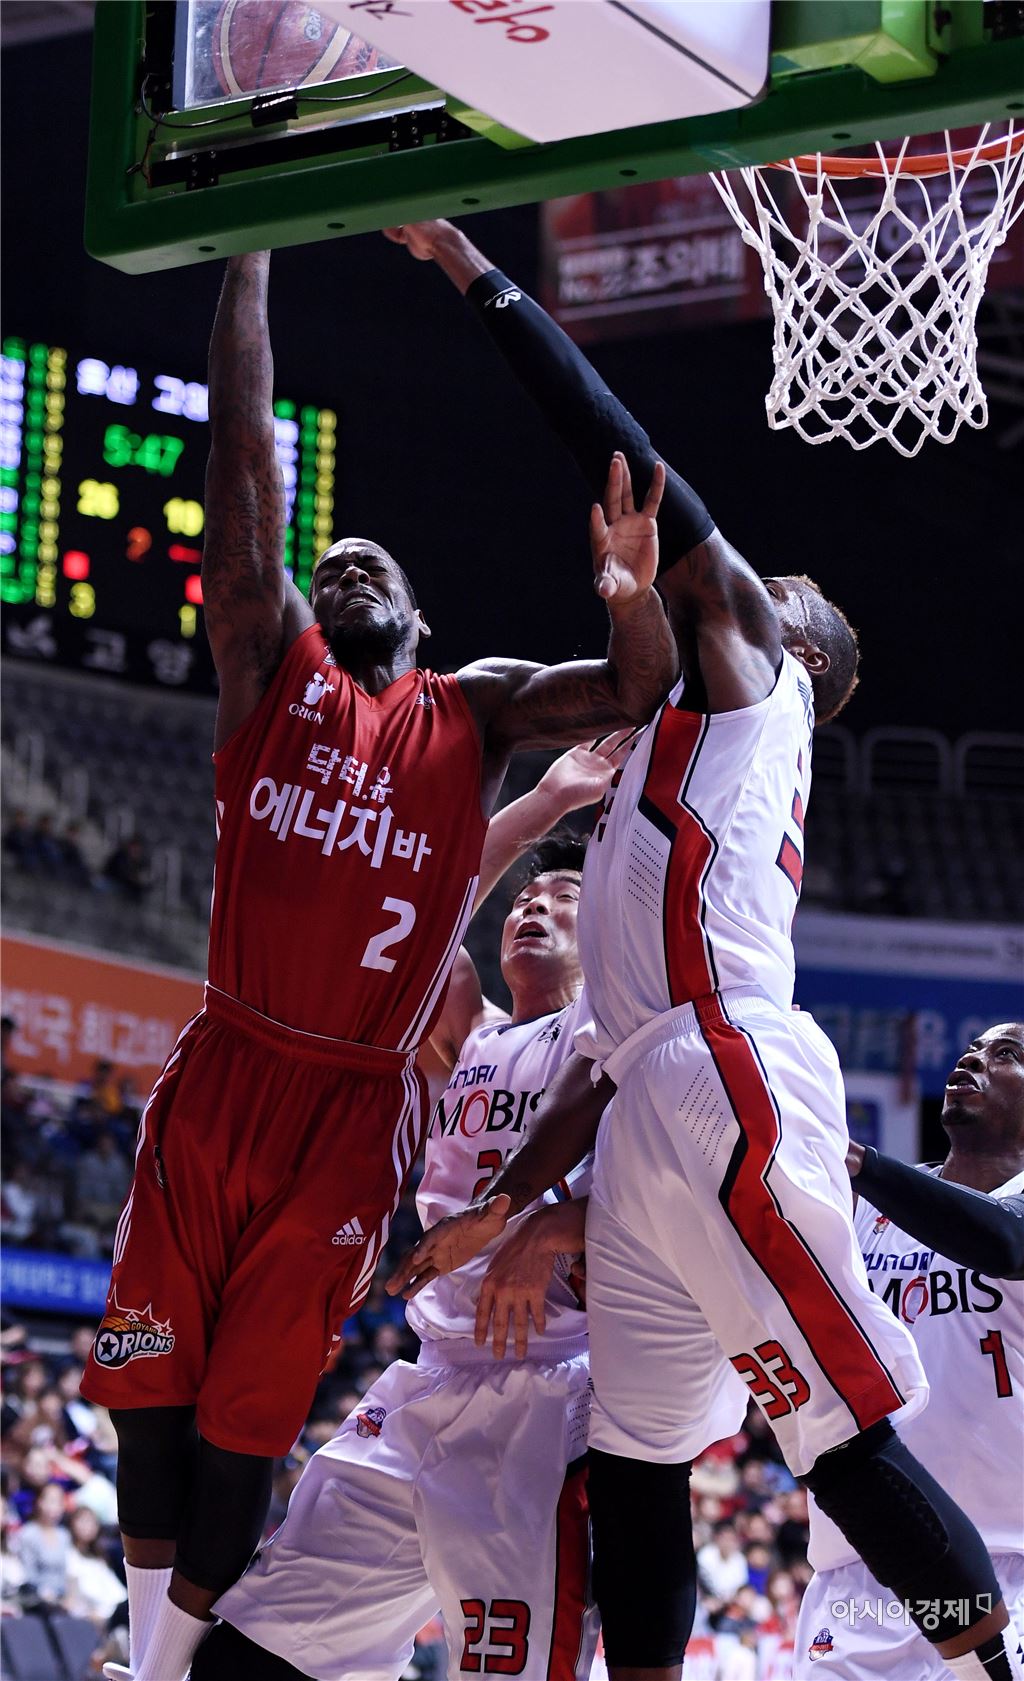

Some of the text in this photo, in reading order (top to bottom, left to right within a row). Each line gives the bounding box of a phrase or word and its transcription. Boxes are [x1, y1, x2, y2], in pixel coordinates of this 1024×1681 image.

[288, 703, 325, 725] ORION
[249, 777, 432, 872] 에너지바
[360, 896, 416, 973] 2
[97, 1332, 174, 1362] ORIONS
[729, 1340, 811, 1421] 33
[979, 1330, 1014, 1398] 1
[460, 1598, 531, 1676] 23
